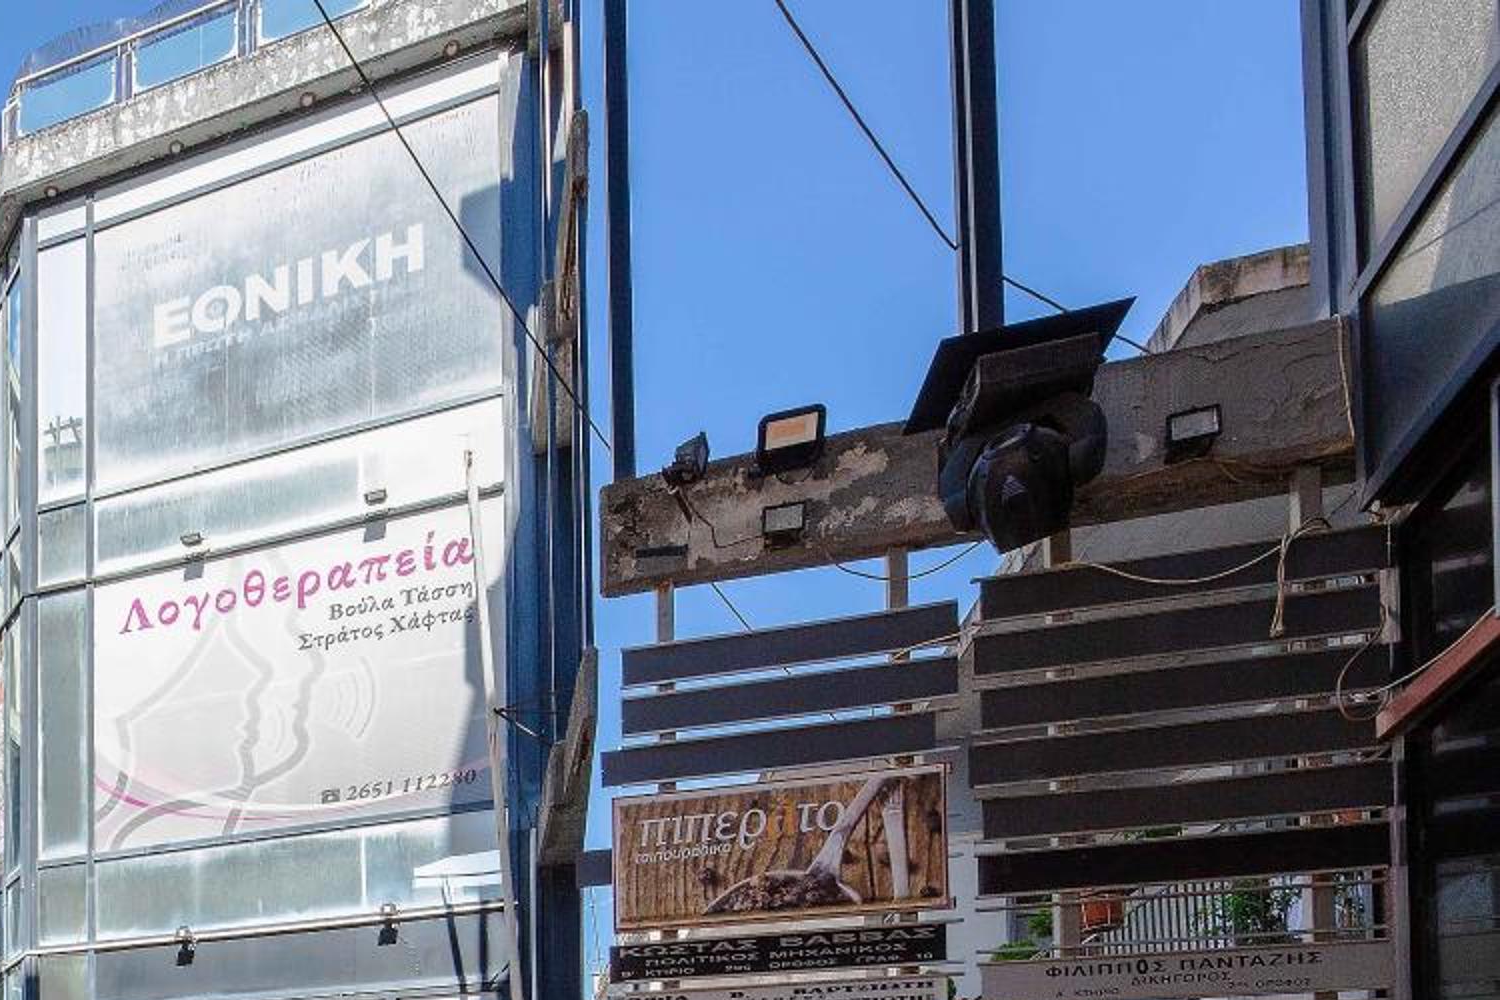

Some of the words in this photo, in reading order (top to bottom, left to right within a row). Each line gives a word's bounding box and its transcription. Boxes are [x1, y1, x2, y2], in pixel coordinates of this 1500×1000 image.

[119, 531, 474, 634] Λογοθεραπεία
[328, 596, 395, 621] Βούλα
[399, 581, 474, 606] Τάσση
[297, 626, 384, 651] Στράτος
[388, 606, 477, 634] Χάφτας
[346, 781, 393, 800] 2651
[619, 939, 758, 958] ΚΩΣΤΑΣ
[779, 927, 938, 947] ΒΑΒΒΑΣ
[645, 951, 760, 967] ΠΟΛΙΤΙΚΟΣ
[769, 943, 908, 959] ΜΗΧΑΝΙΚΟΣ
[1045, 959, 1167, 978] ΦΙΛΙΠΠΟΣ
[1180, 951, 1324, 971] ΠΑΝΤΑΖΗΣ
[1131, 971, 1232, 986] ΔΙΚΗΓΟΡΟΣ
